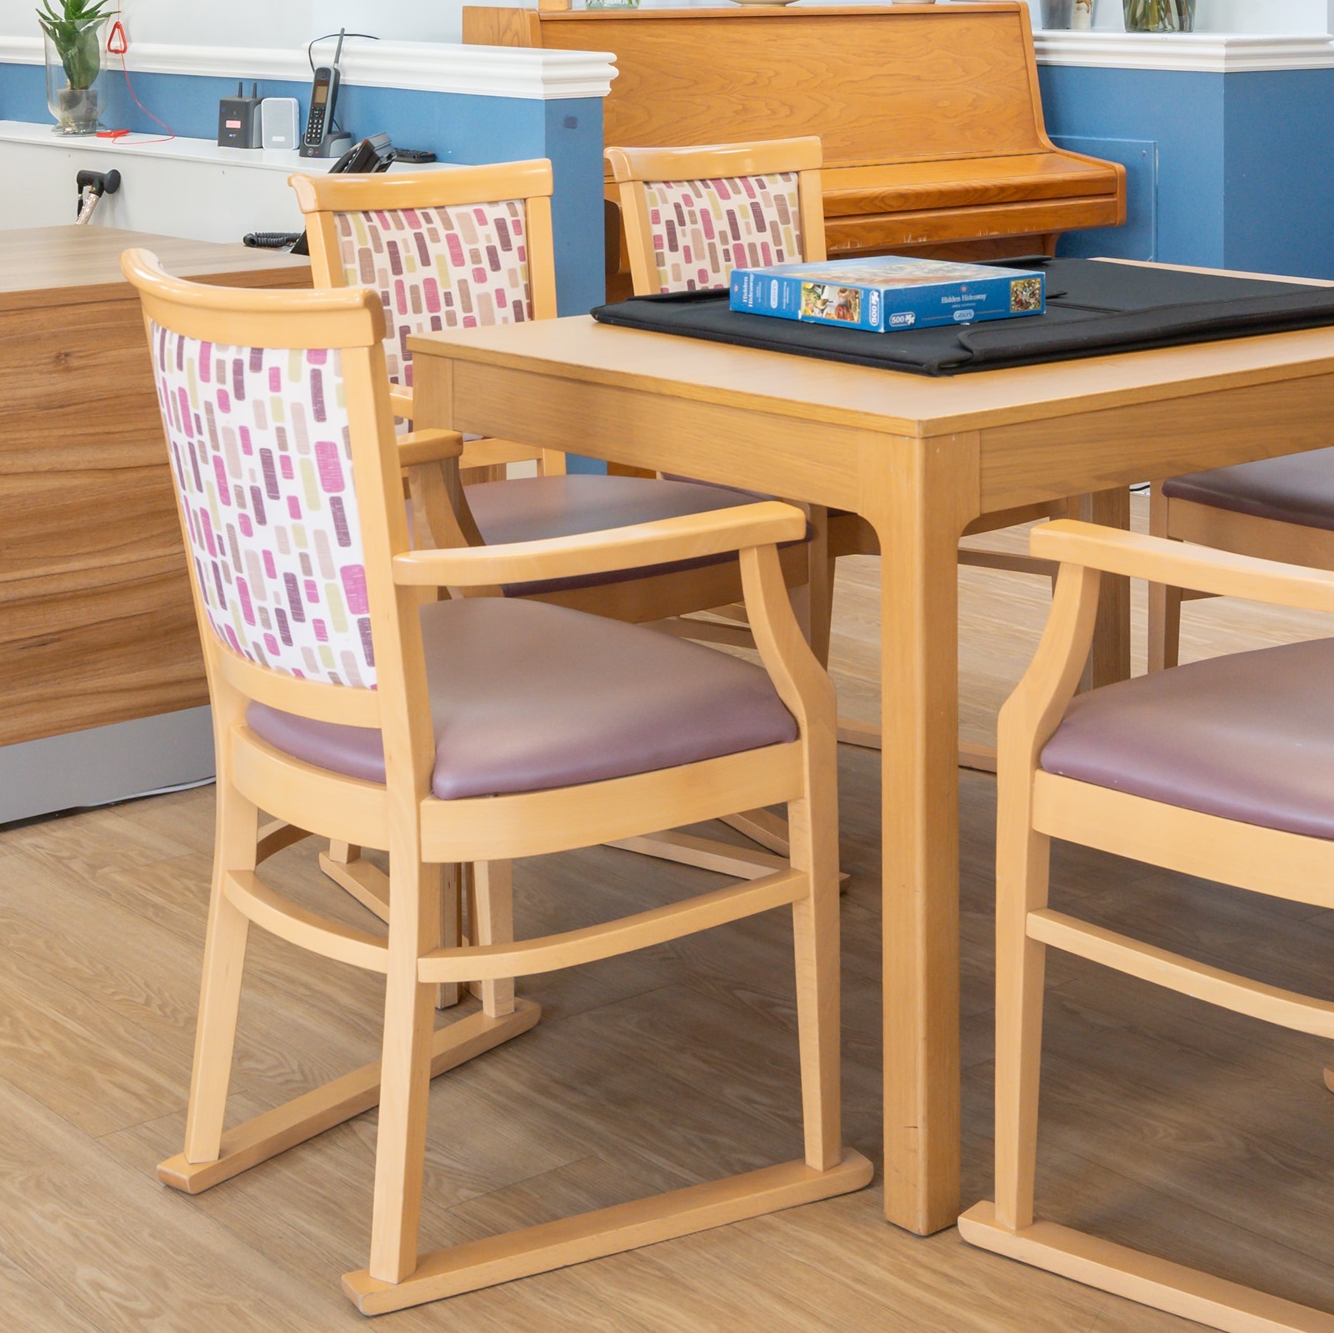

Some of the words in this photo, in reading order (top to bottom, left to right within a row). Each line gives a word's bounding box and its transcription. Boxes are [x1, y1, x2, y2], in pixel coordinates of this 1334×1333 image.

[941, 296, 961, 304] Hidden
[962, 294, 987, 302] Hideaway
[891, 315, 904, 324] 500
